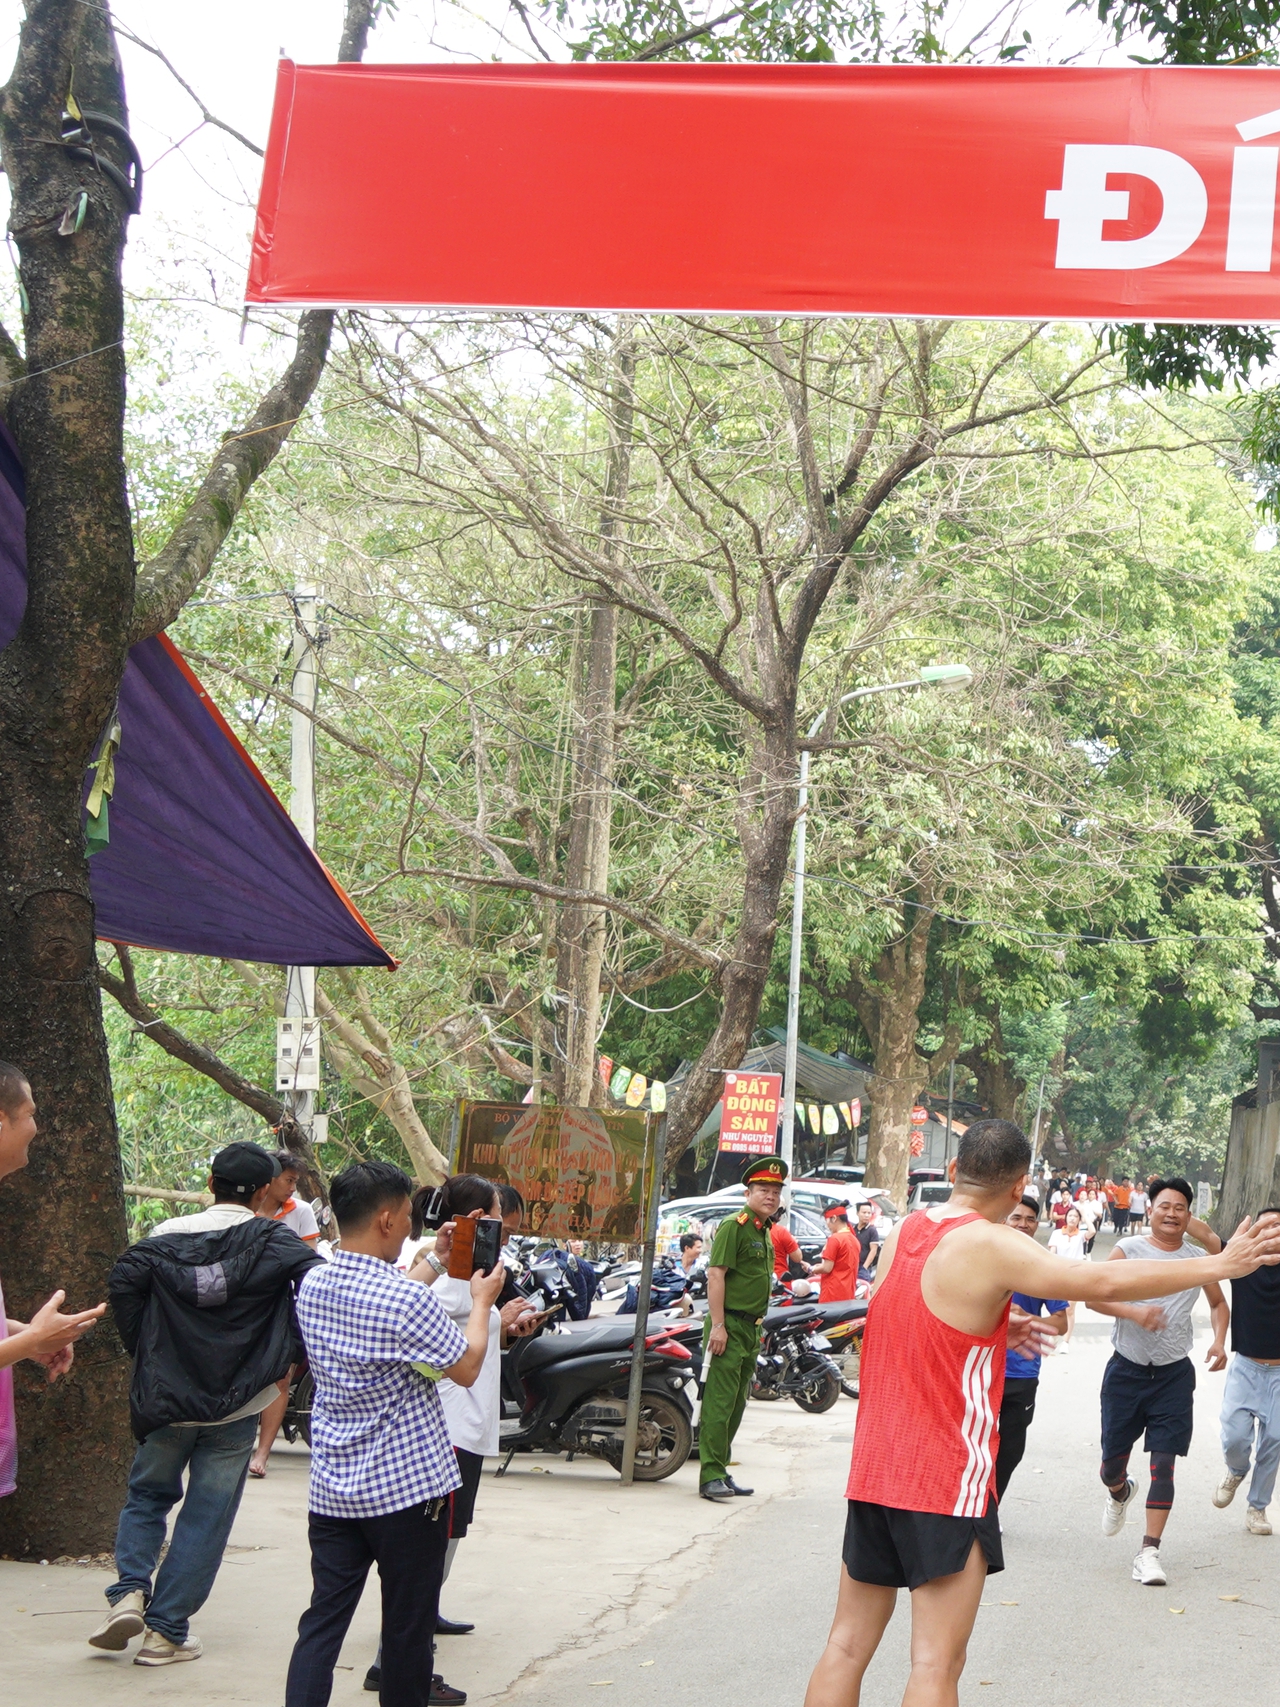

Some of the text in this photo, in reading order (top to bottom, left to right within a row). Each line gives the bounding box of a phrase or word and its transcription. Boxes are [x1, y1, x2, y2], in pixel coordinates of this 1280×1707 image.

[735, 1076, 771, 1095] BẤT
[726, 1094, 777, 1114] ĐỘNG
[494, 1112, 510, 1125] BỘ
[606, 1120, 625, 1130] TIN
[730, 1112, 769, 1132] SẢN
[722, 1132, 774, 1145] NHƯ NGUYỆT
[472, 1143, 497, 1165] KHU
